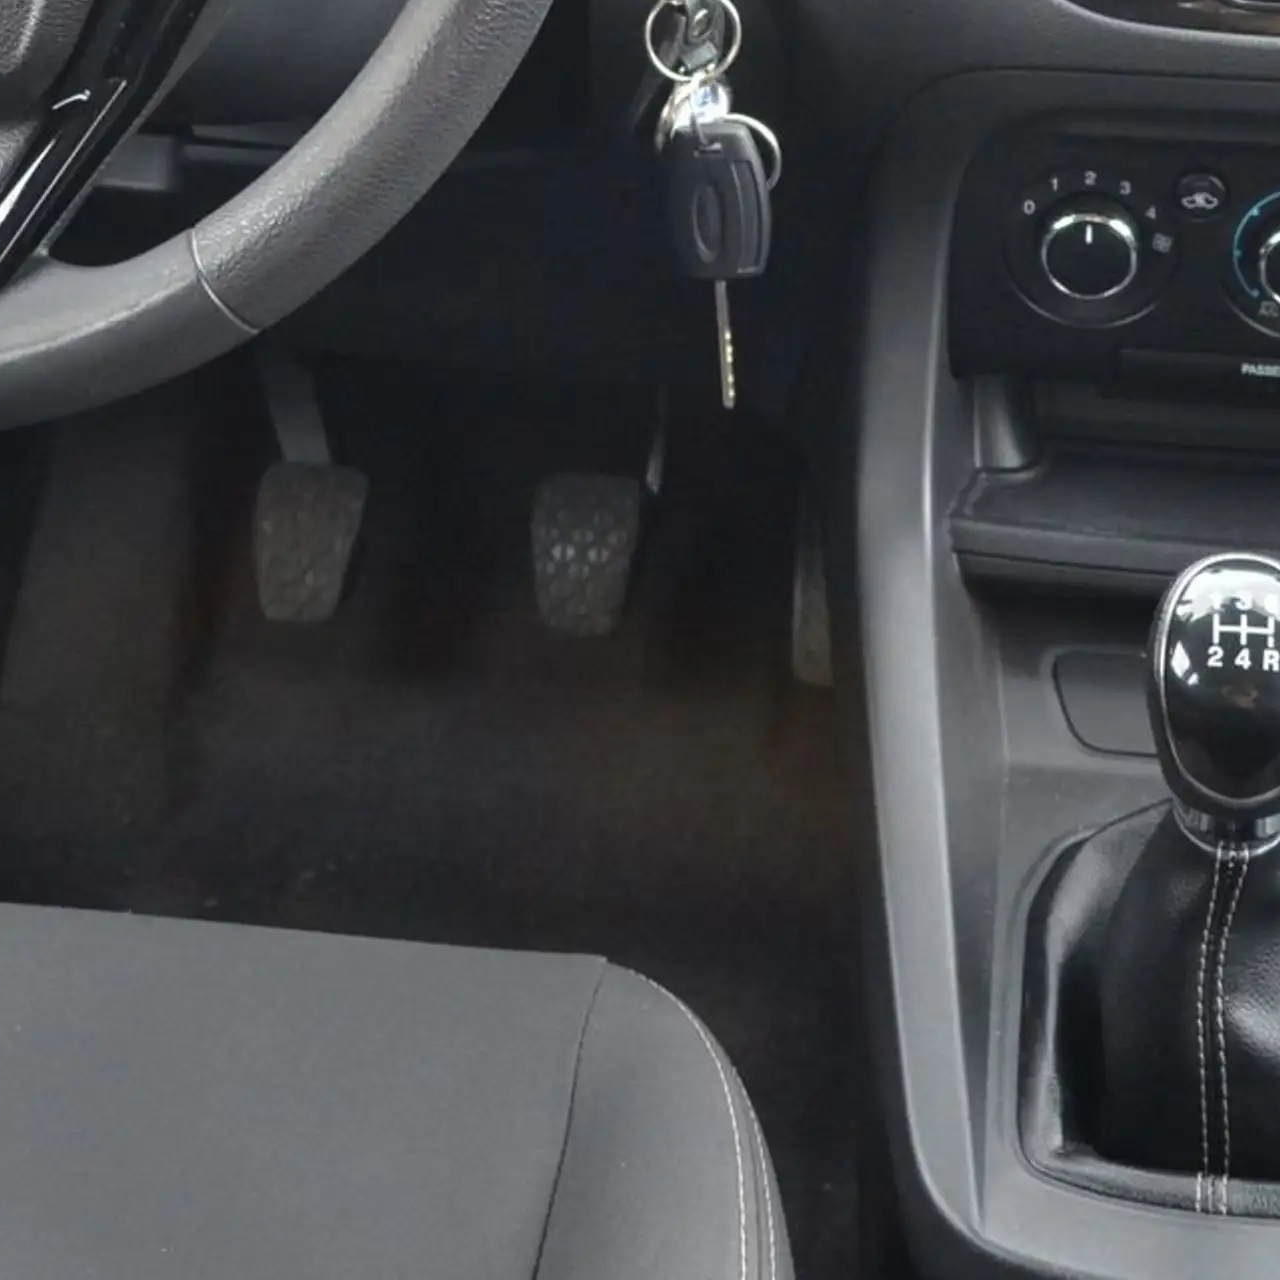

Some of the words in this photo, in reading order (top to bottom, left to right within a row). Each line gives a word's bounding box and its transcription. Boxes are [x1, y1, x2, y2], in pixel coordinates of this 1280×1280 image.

[1023, 199, 1036, 215] 0
[1050, 177, 1058, 191] 1
[1084, 170, 1098, 186] 2
[1119, 180, 1132, 195] 3
[1145, 205, 1157, 220] 4
[1206, 645, 1224, 668] 2
[1234, 647, 1252, 670] 4
[1262, 648, 1280, 672] R
